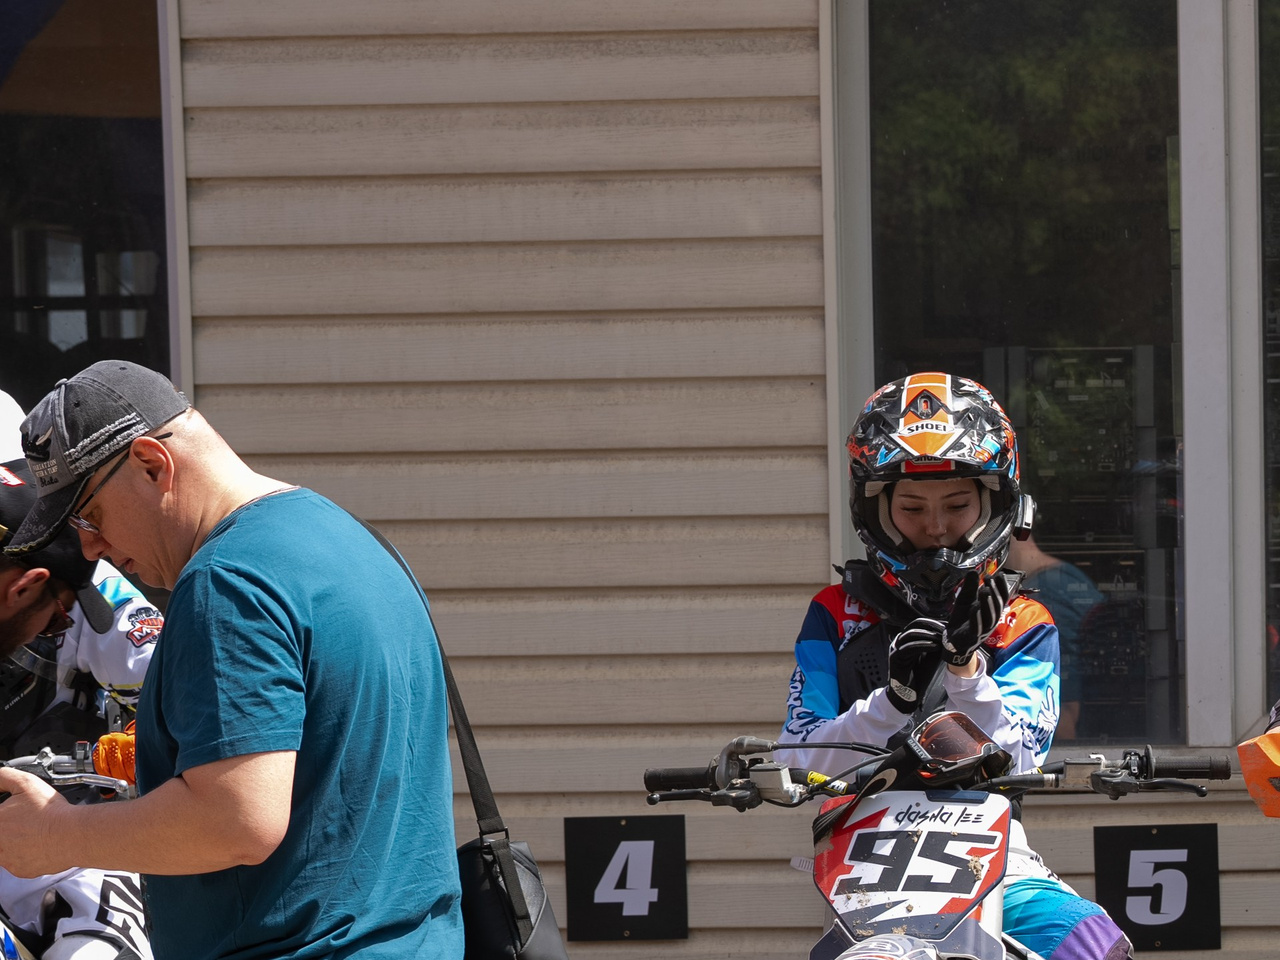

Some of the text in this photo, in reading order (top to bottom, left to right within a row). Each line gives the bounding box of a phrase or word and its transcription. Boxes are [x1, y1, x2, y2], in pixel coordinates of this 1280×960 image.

[906, 422, 948, 434] SHOEI
[907, 738, 927, 760] OAKLEY
[594, 840, 659, 917] 4
[833, 830, 998, 896] 95
[1125, 848, 1189, 926] 5
